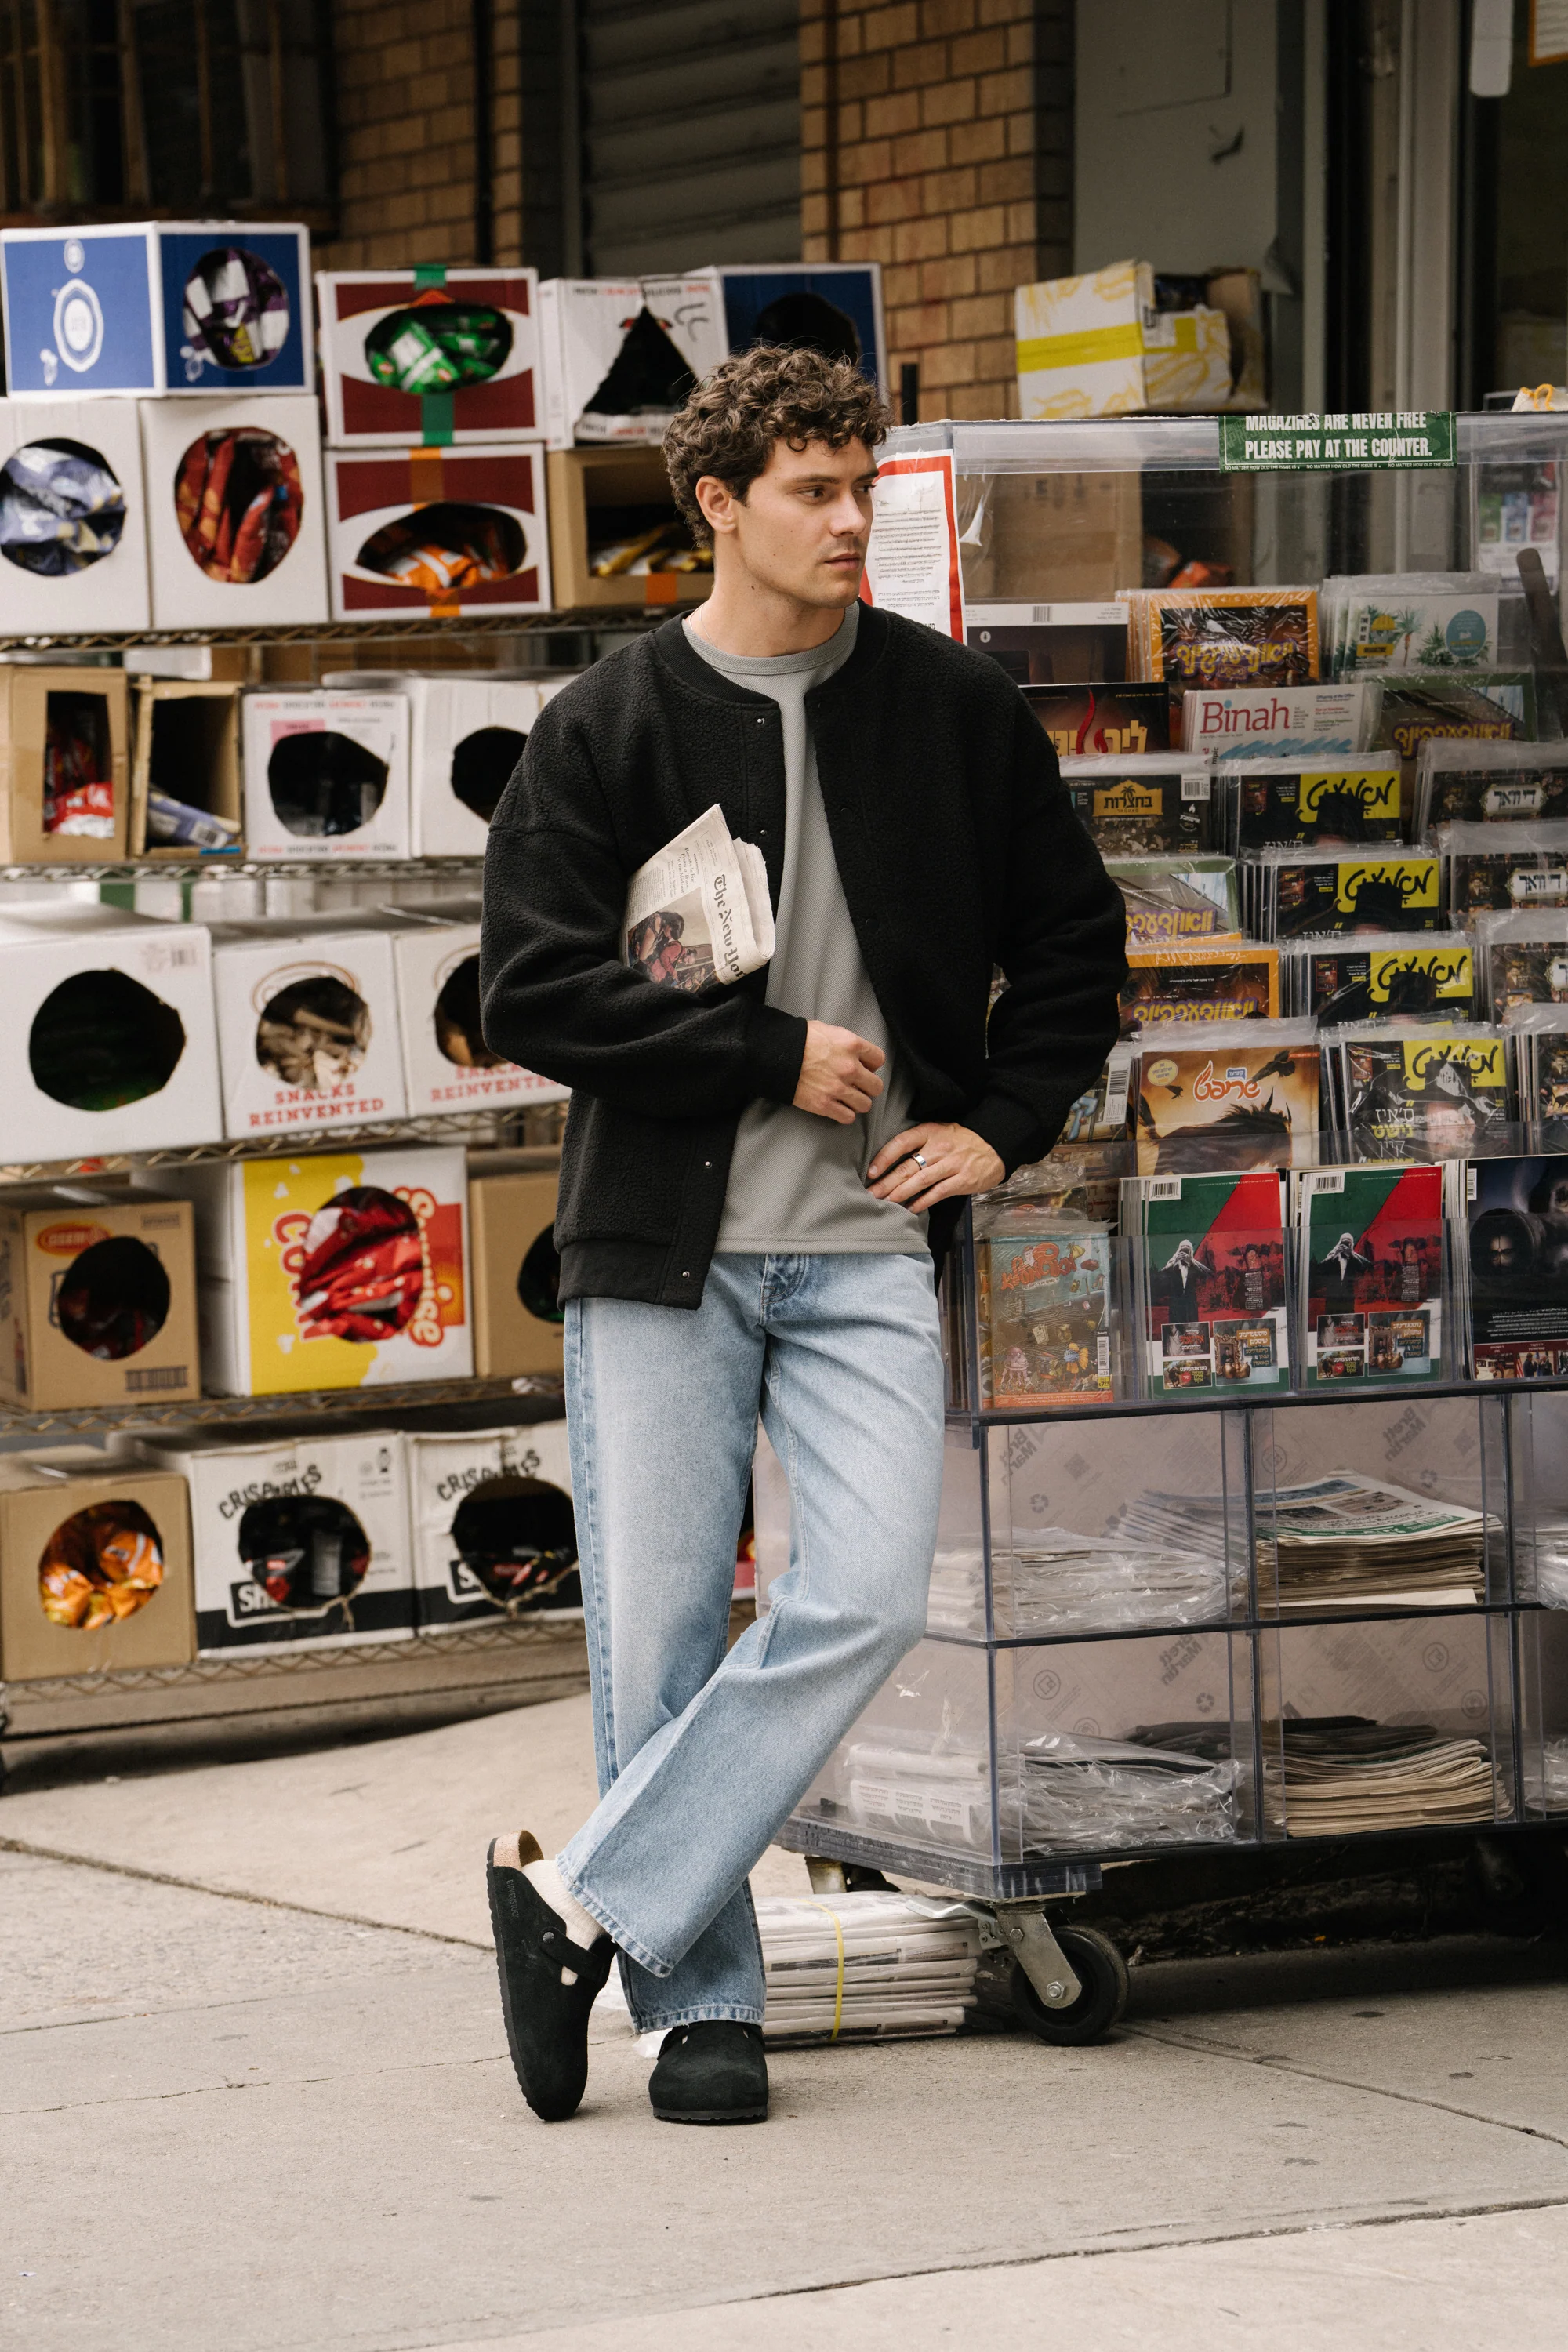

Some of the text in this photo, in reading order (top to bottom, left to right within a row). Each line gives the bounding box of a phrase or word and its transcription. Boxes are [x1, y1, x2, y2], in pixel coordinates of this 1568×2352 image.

[1245, 412, 1427, 431] MAGAZINES ARE NEVER FREE
[1245, 437, 1432, 459] PLEASE PAY AT THE COUNTER.
[1200, 698, 1290, 734] Binah
[1104, 796, 1152, 809] בחצרות
[713, 873, 727, 908] The
[719, 908, 734, 946] New
[431, 1075, 558, 1102] REINVENTE
[1194, 1062, 1261, 1101] שריפט
[250, 1098, 384, 1127] REINVENTED
[1377, 1140, 1406, 1158] קיין
